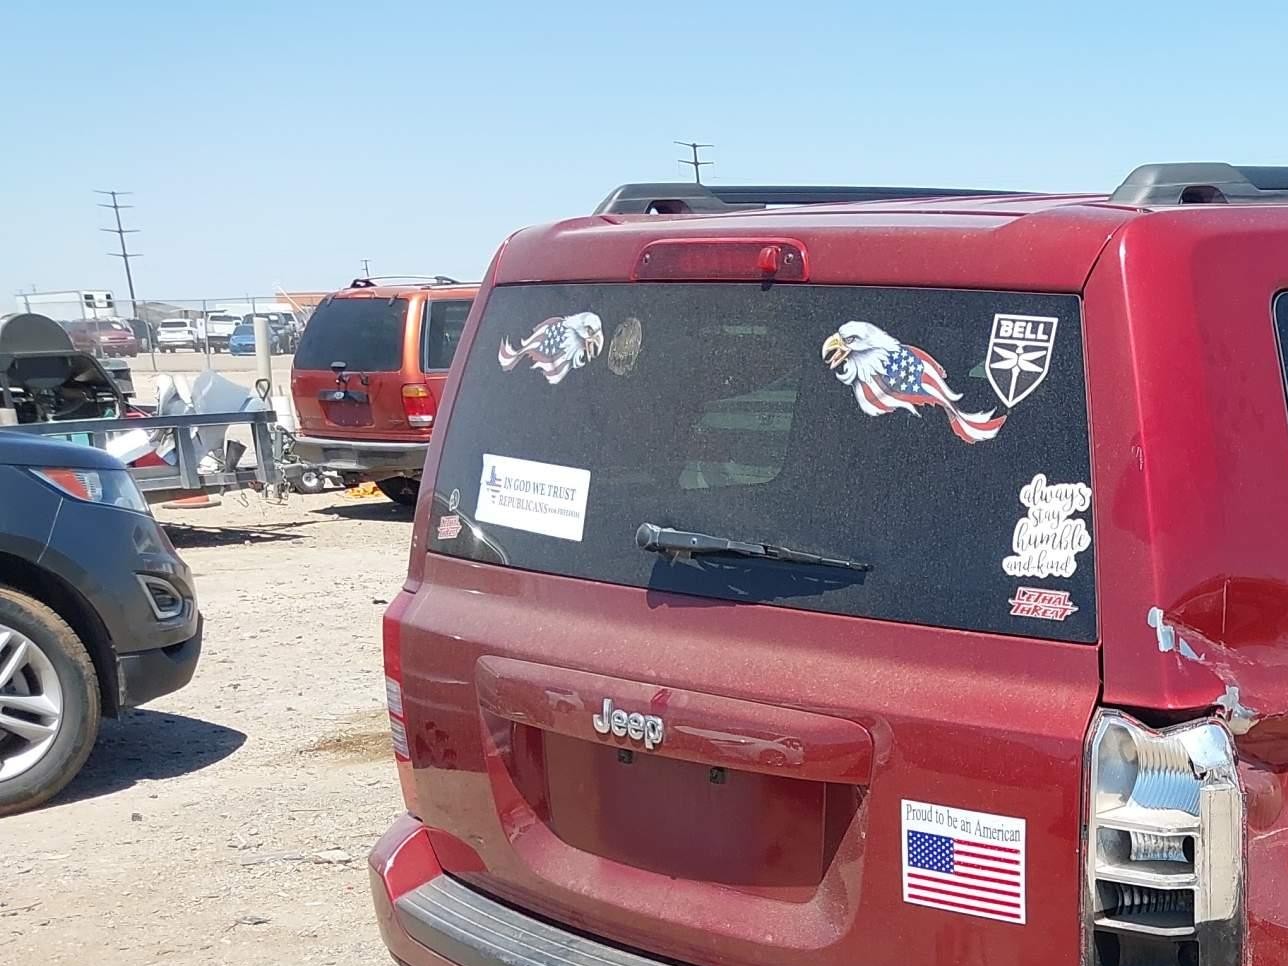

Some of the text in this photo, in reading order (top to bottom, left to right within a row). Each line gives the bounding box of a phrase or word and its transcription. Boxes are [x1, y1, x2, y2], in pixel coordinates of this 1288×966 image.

[1000, 320, 1049, 340] BELL
[503, 476, 577, 501] IN GOD WE TRUST
[1023, 478, 1087, 512] always
[499, 494, 549, 514] REPUBLICANS
[1031, 507, 1061, 529] stay
[1016, 522, 1088, 552] humble
[592, 698, 665, 750] Jeep
[905, 803, 1021, 842] Proud to be an American
